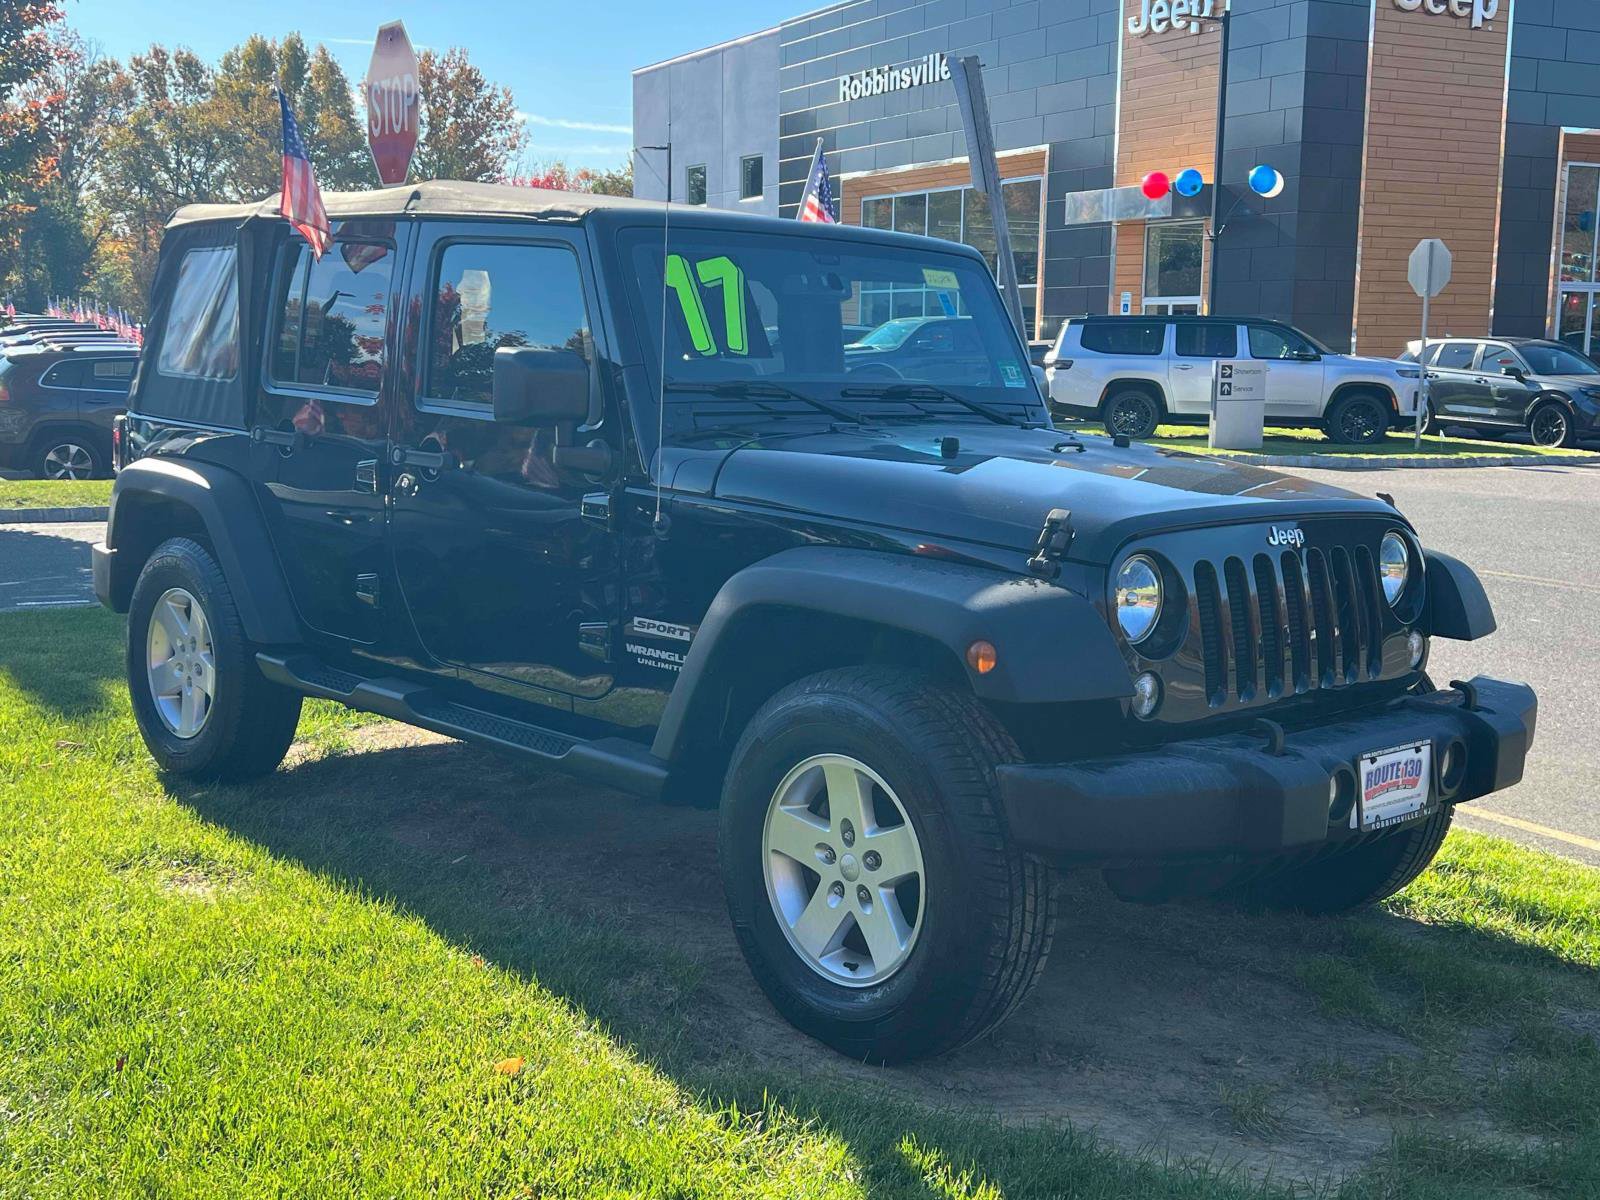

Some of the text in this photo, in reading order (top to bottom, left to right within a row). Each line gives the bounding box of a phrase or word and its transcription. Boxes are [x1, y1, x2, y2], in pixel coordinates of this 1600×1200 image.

[839, 52, 951, 102] Robbinsville
[371, 73, 415, 138] STOP
[666, 254, 748, 356] 17
[1269, 526, 1304, 548] Jeep
[636, 620, 690, 637] SPORT
[1365, 759, 1422, 791] ROUTE 130
